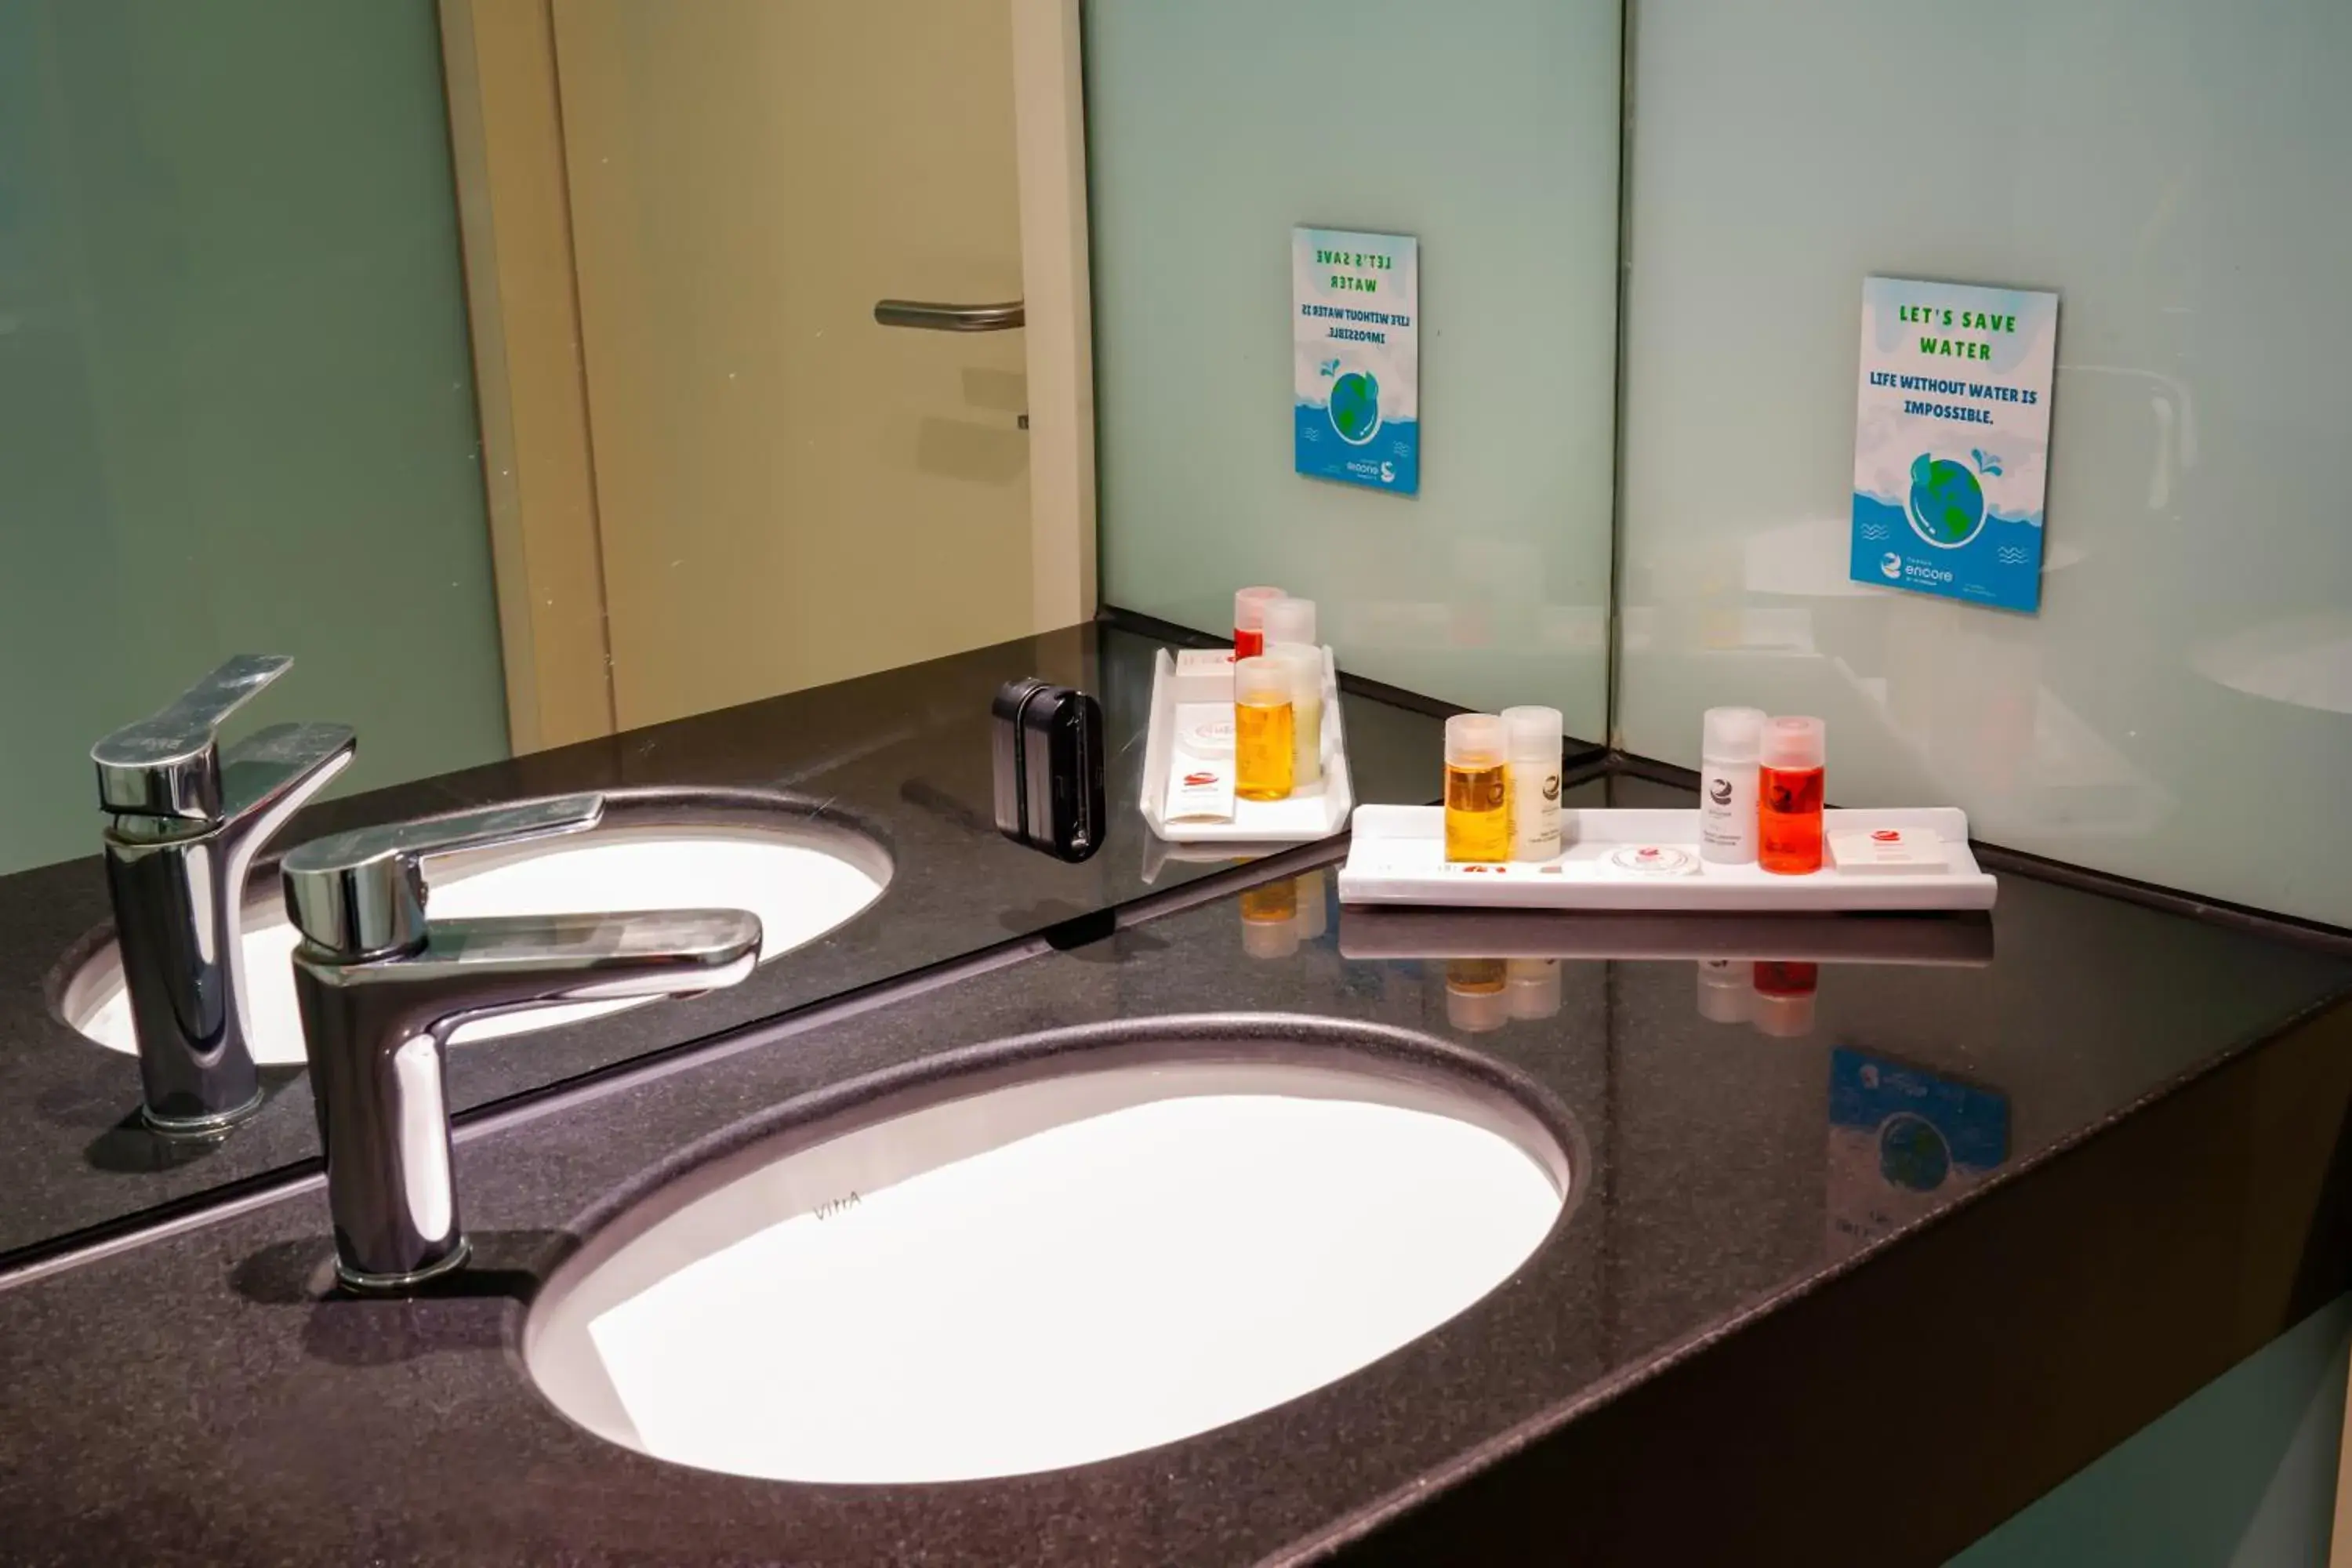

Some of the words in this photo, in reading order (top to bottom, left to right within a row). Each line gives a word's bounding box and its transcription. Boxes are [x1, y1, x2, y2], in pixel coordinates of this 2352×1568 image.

[1899, 305, 1954, 325] LET'S
[1962, 311, 2016, 333] SAVE
[1920, 336, 1992, 361] WATER
[1870, 371, 1897, 388] LIFE
[1900, 375, 1966, 396] WITHOUT
[1969, 383, 2019, 402] WATER
[2020, 389, 2038, 405] IS
[1904, 400, 1994, 425] IMPOSSIBLE.
[1905, 565, 1954, 583] encore
